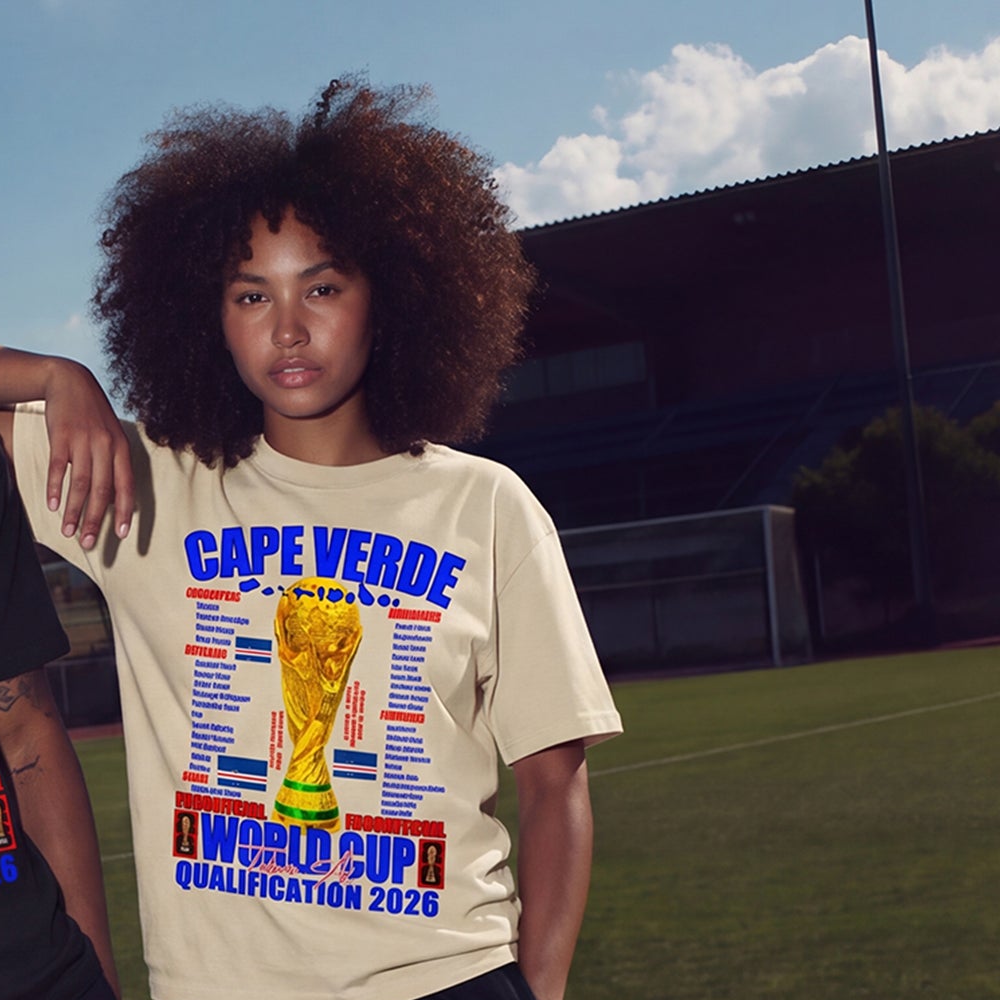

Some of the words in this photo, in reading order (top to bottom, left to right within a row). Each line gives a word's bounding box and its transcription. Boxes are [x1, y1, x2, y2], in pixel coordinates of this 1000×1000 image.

[184, 525, 304, 582] CAPE
[313, 525, 466, 609] VERDE
[201, 812, 332, 876] WORLD
[339, 831, 416, 884] CUP
[175, 860, 362, 911] QUALIFICATION
[368, 886, 440, 918] 2026
